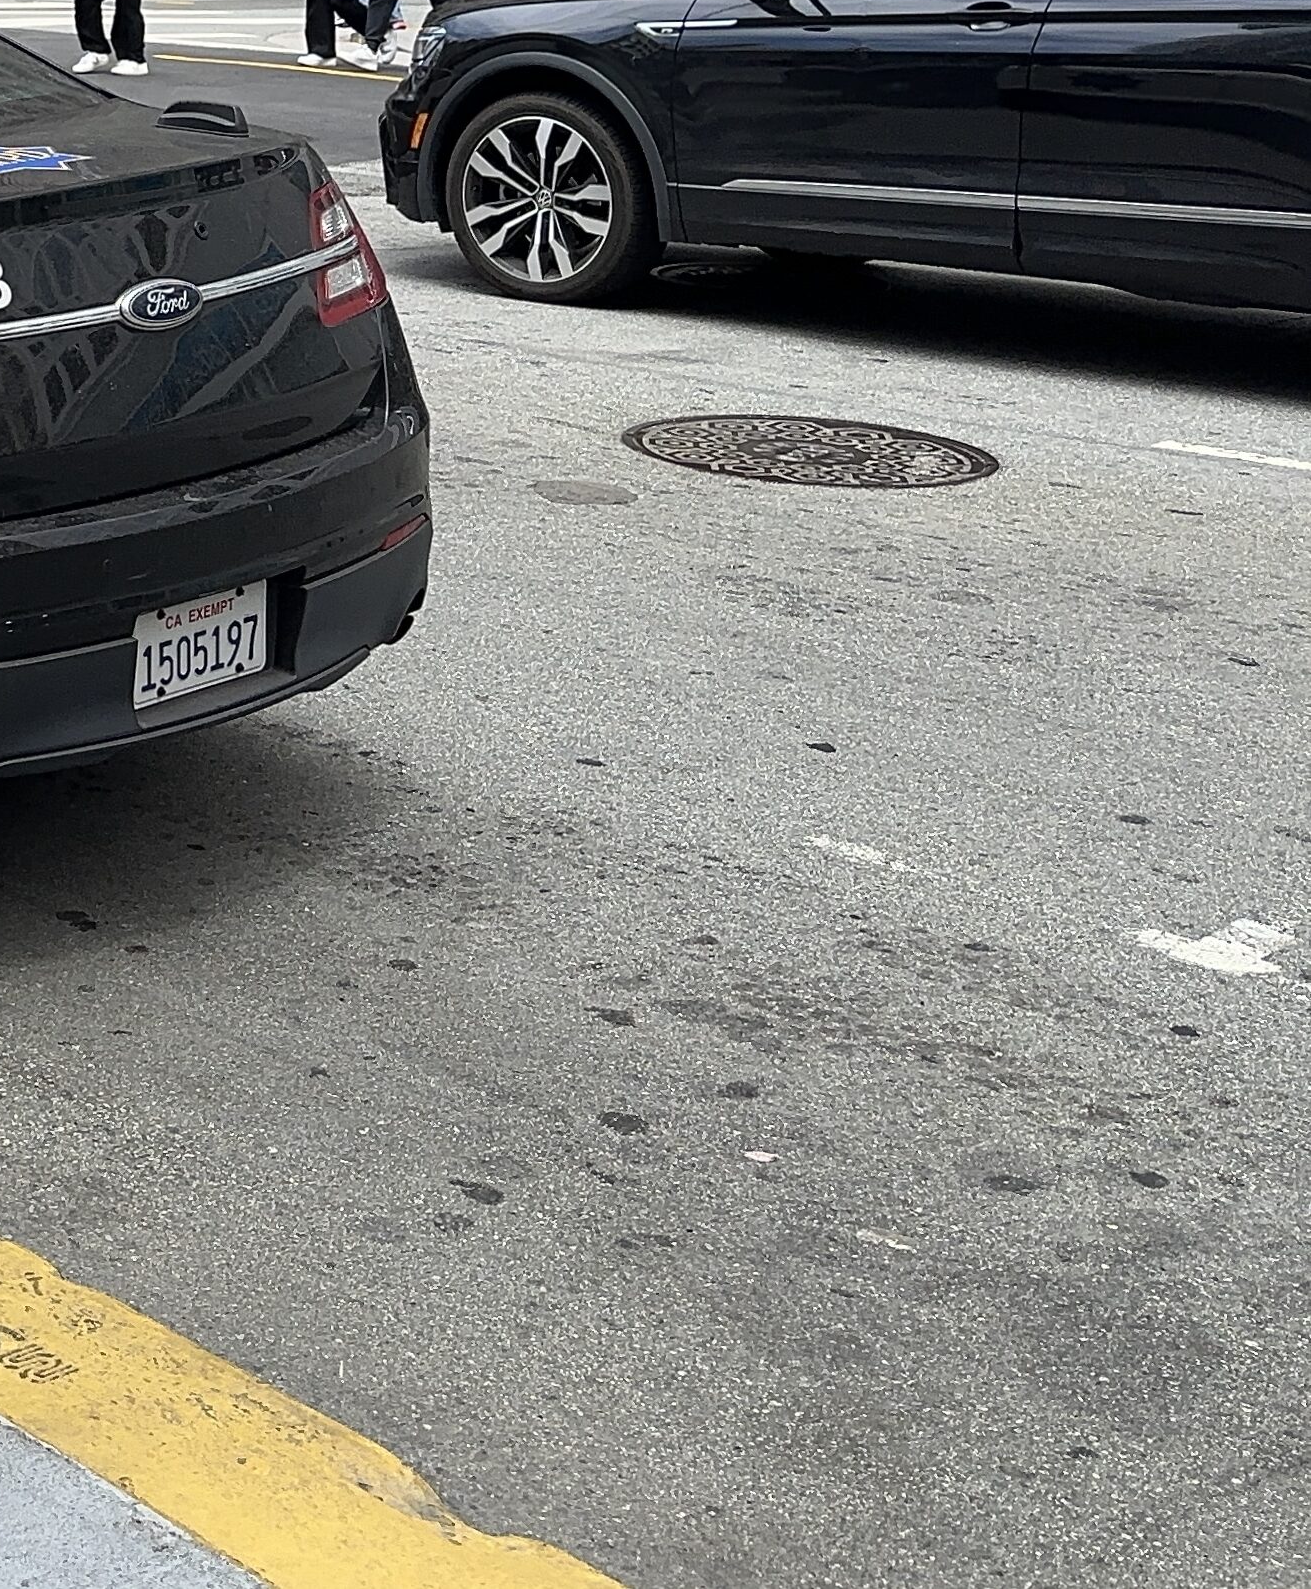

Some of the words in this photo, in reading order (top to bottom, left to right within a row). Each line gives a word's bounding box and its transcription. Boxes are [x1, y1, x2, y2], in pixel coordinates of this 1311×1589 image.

[146, 286, 190, 317] Ford
[165, 615, 183, 630] CA
[188, 597, 235, 624] EXEMPT
[141, 613, 258, 693] 1505197
